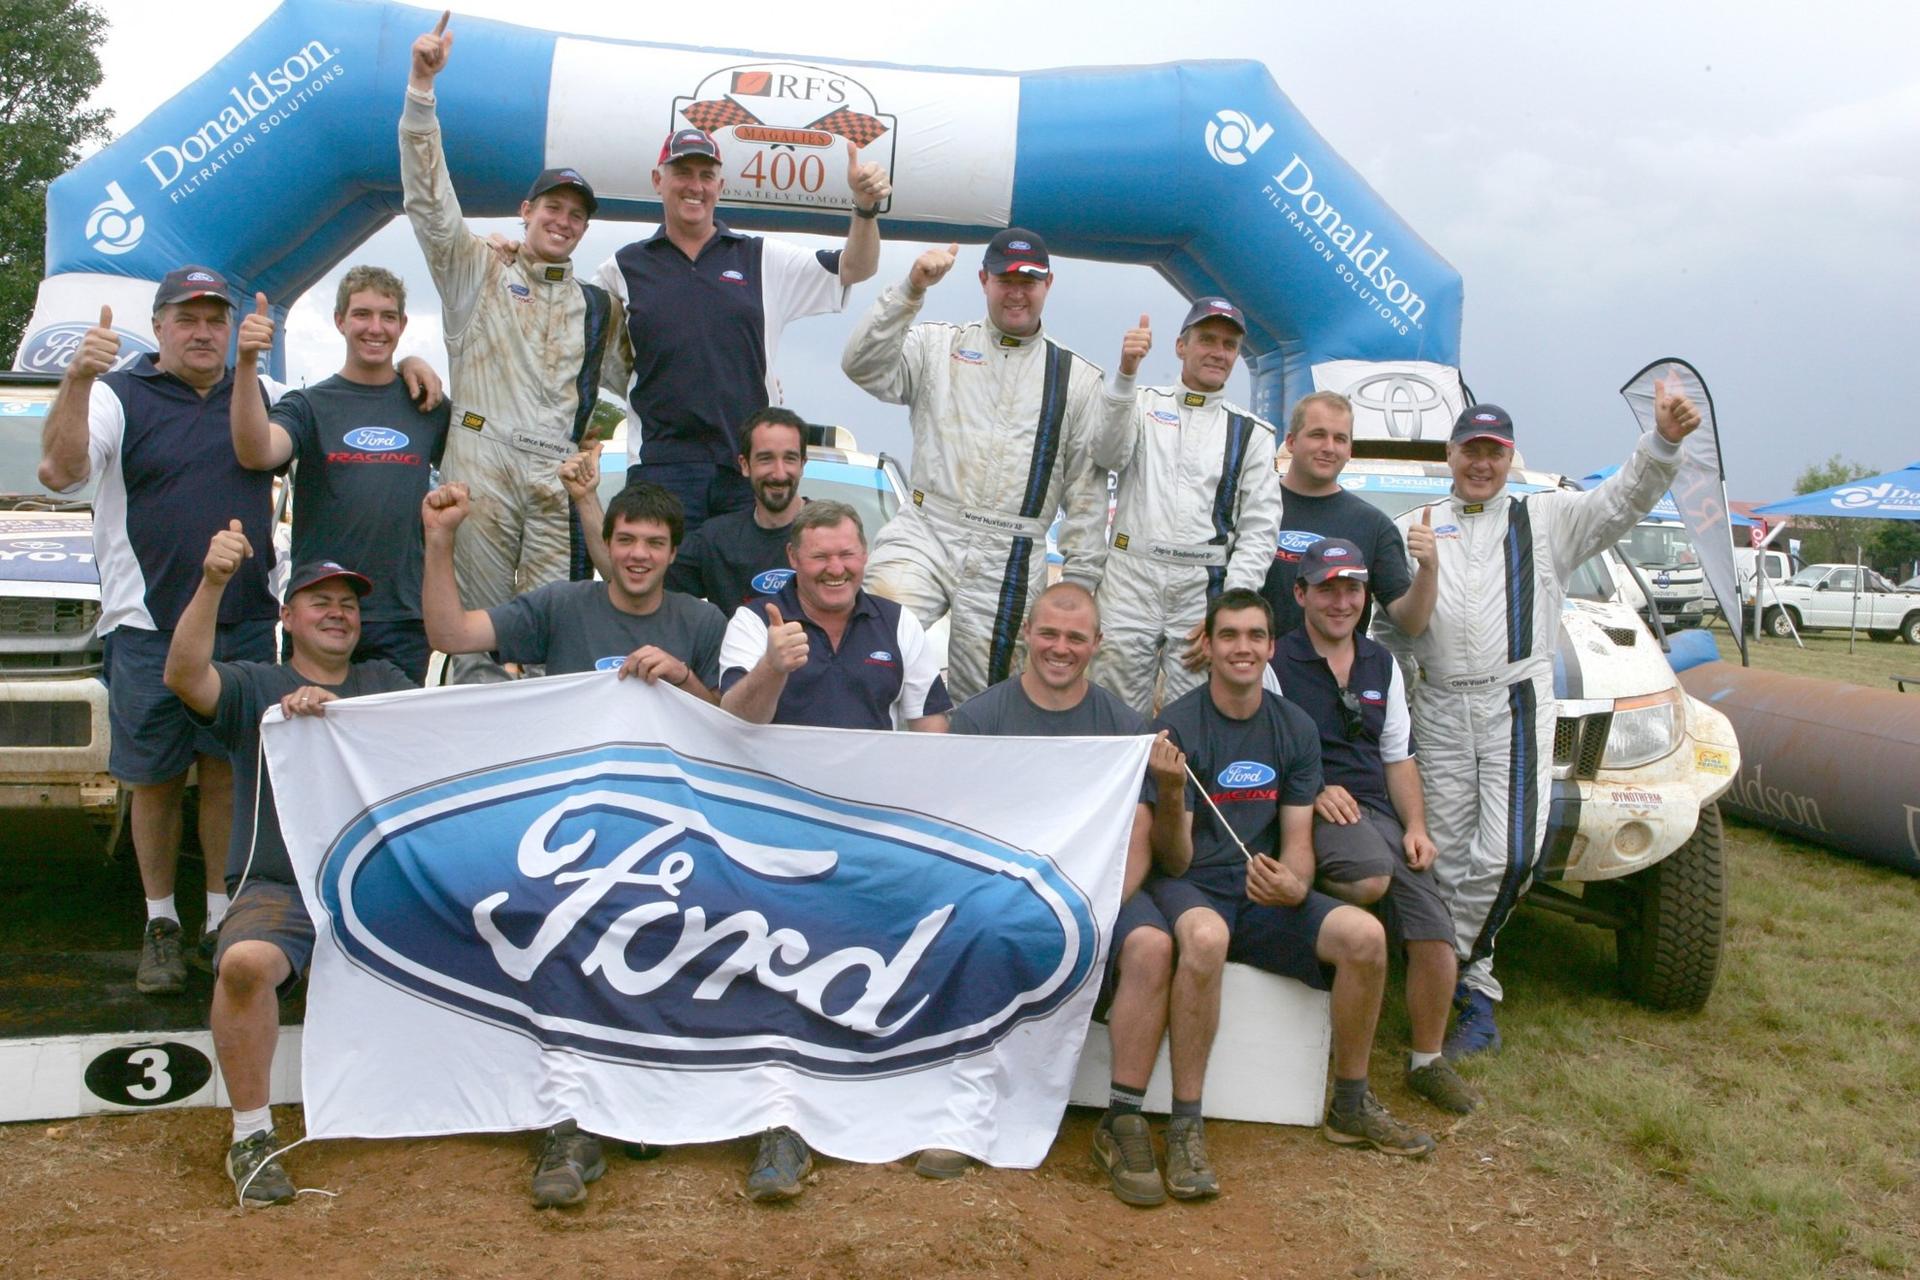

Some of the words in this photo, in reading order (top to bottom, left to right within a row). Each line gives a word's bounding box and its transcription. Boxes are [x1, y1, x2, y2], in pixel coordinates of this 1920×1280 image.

[776, 74, 846, 103] RFS
[140, 40, 335, 191] Donaldson
[170, 133, 257, 205] FILTRATION
[259, 64, 345, 134] SOLUTIONS
[743, 127, 826, 145] MAGALIES
[740, 150, 825, 193] 400
[722, 188, 791, 201] ONATELY
[796, 193, 855, 206] TOMOR
[1272, 152, 1426, 325] Donaldson
[1262, 184, 1334, 262] FILTRATION
[1335, 263, 1409, 336] SOLUTIONS
[33, 330, 140, 372] Fod
[357, 429, 396, 447] Ford
[327, 452, 421, 465] RACING
[1380, 475, 1453, 488] Donalds
[0, 550, 95, 563] YOT
[762, 572, 788, 590] For
[1226, 765, 1262, 784] Ford
[1611, 791, 1663, 804] DYNOTHERM
[472, 790, 956, 1038] Ford
[125, 1048, 172, 1100] 3
